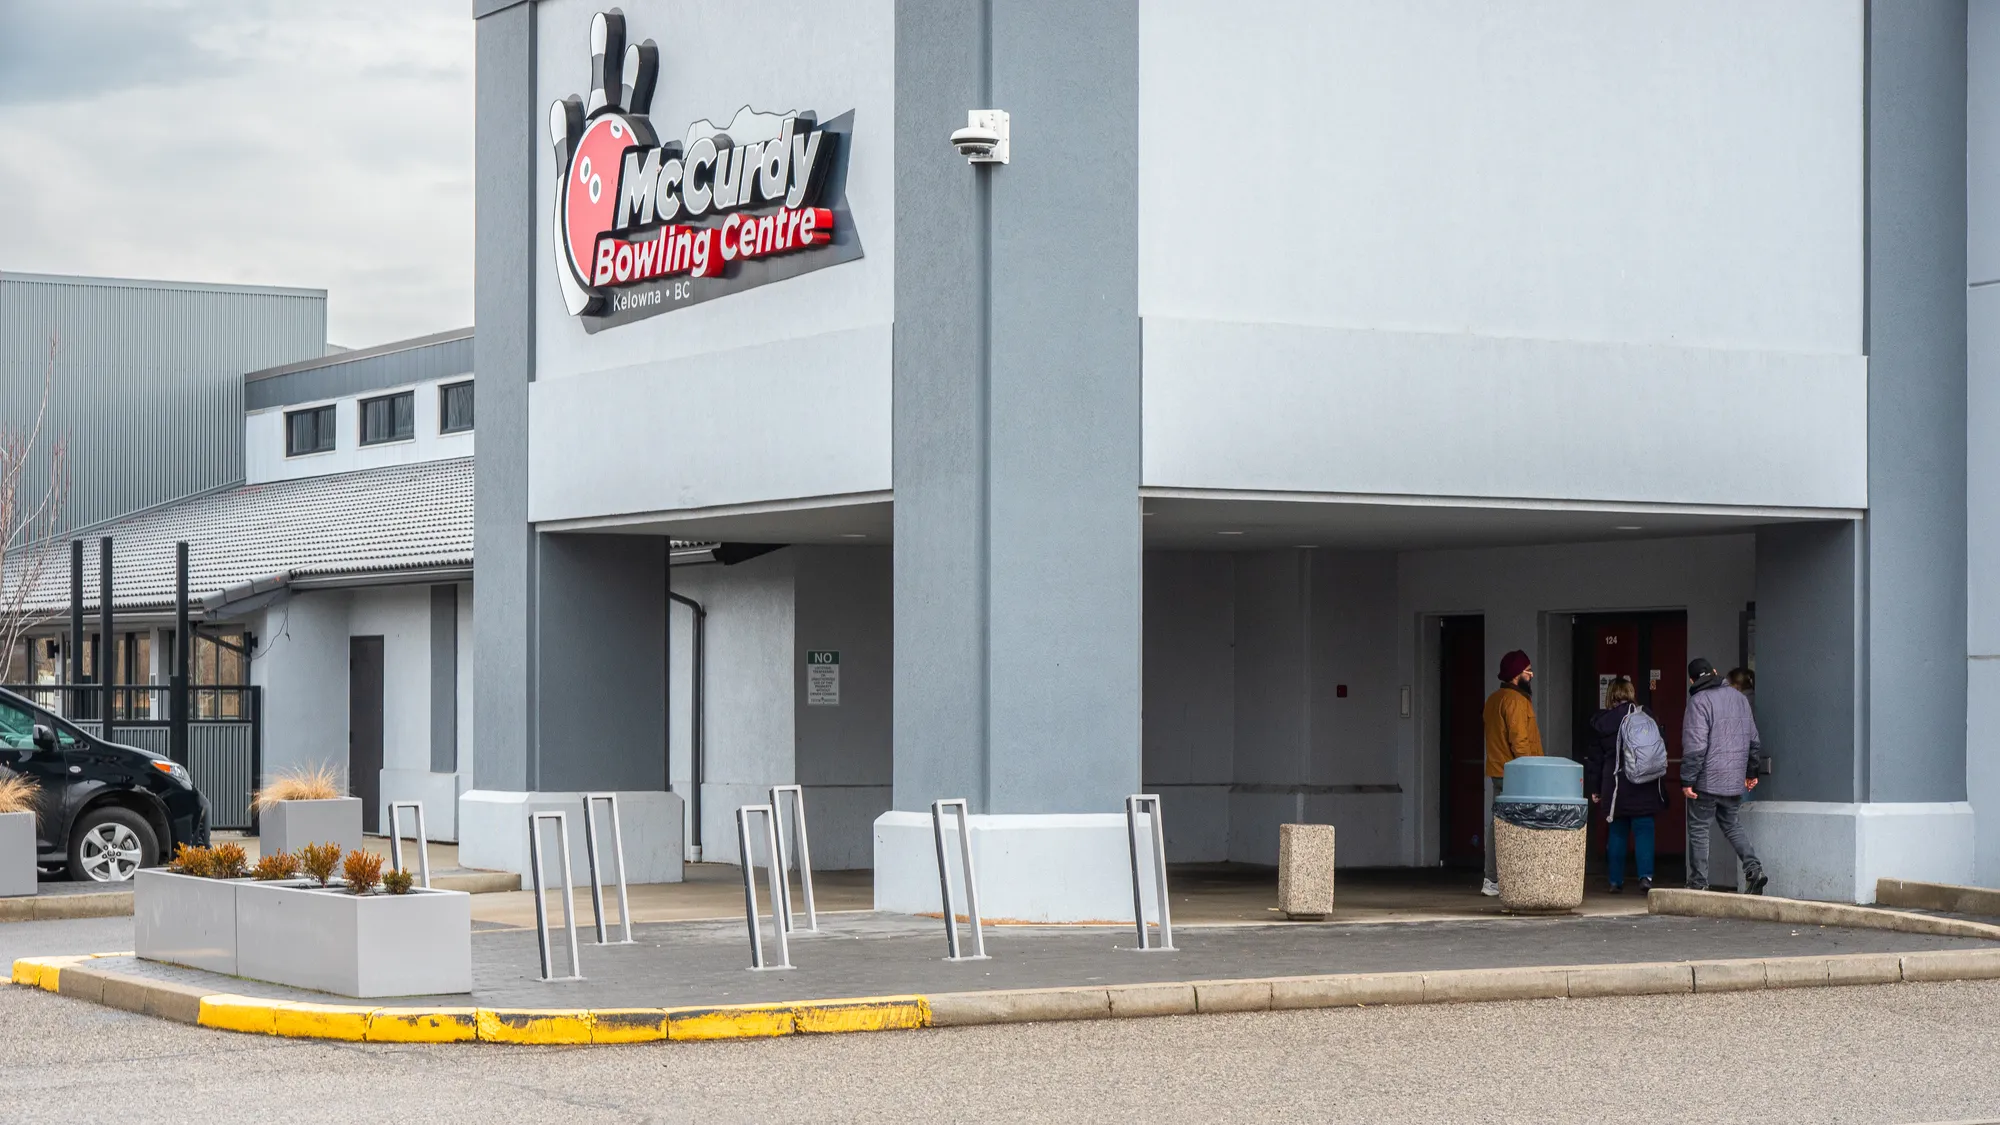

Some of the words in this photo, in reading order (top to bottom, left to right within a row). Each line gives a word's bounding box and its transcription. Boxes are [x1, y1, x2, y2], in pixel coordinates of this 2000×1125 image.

[617, 117, 823, 230] McCurdy
[593, 226, 713, 287] Bowling
[720, 206, 816, 261] Centre
[613, 291, 661, 312] Kelowna
[674, 281, 690, 301] BC
[1606, 636, 1618, 645] 124
[814, 652, 832, 664] NO
